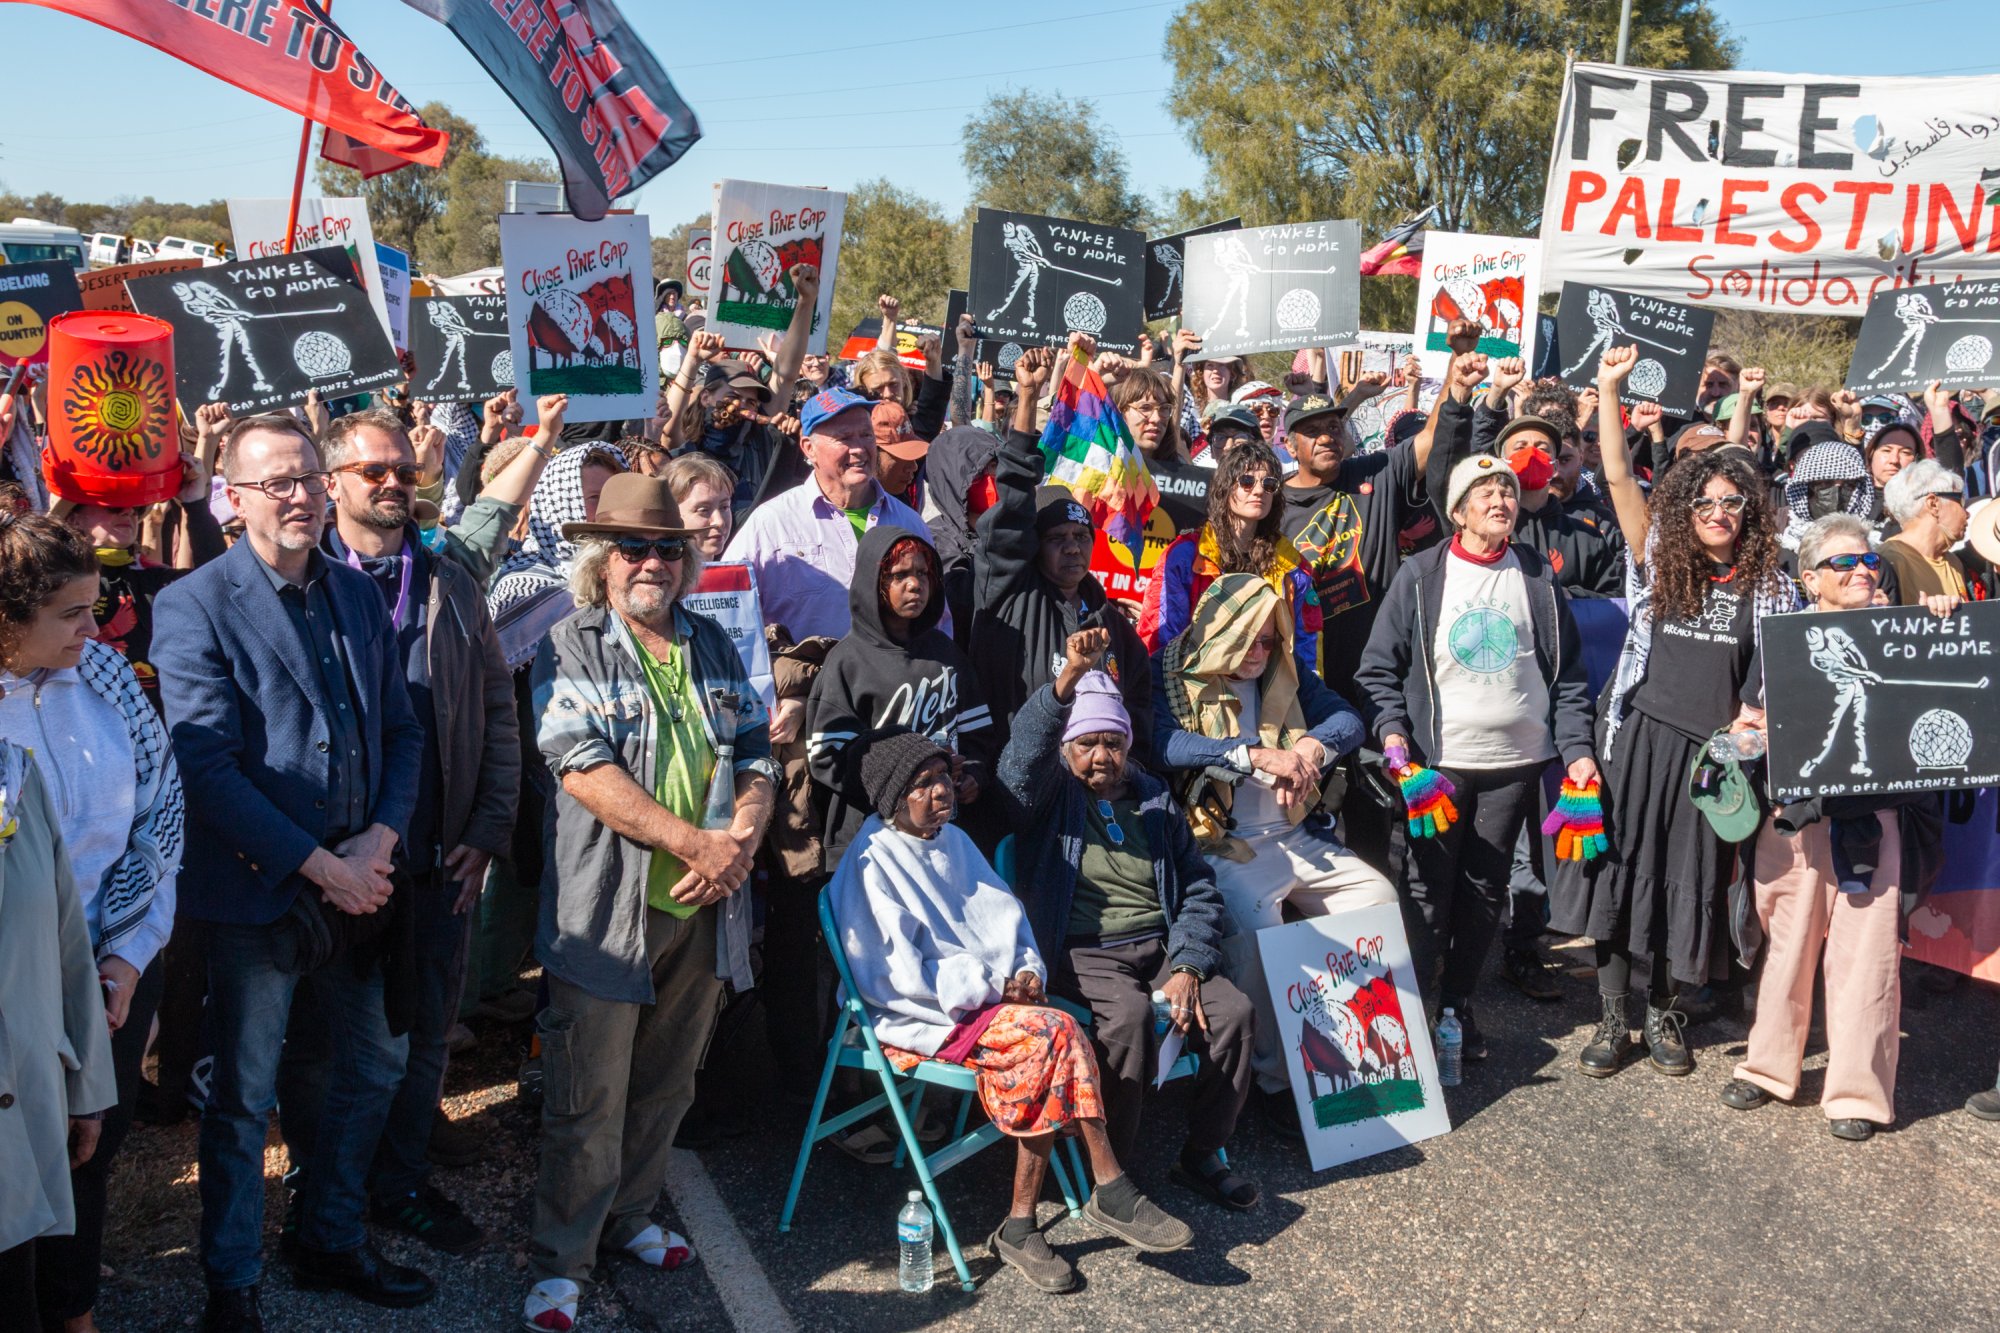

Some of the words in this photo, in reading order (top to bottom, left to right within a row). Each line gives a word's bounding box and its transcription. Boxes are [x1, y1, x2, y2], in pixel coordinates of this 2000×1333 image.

[168, 0, 272, 47] ERE
[284, 6, 345, 73] TO
[488, 0, 556, 64] ERE
[549, 46, 585, 114] TO
[1571, 71, 1860, 171] FREE
[1048, 225, 1114, 250] YANKEE
[1258, 226, 1326, 241] YANKEE
[1054, 242, 1077, 256] GO
[1083, 249, 1126, 265] HOME
[1263, 245, 1287, 256] GO
[1294, 241, 1340, 255] HOME
[227, 261, 316, 284] YANKEE
[694, 265, 711, 281] 40
[1687, 254, 1962, 307] Solidarit
[245, 287, 277, 299] GO
[286, 277, 340, 296] HOME
[1942, 283, 2000, 297] YANKE
[466, 296, 506, 307] YANK
[1629, 295, 1688, 322] YANKEE
[1945, 298, 1969, 308] GO
[1974, 296, 2000, 308] HO
[6, 314, 23, 325] ON
[474, 311, 494, 321] GO
[1630, 311, 1651, 326] GO
[1655, 319, 1695, 337] HOME
[0, 326, 44, 341] OUNTRY
[974, 325, 993, 335] INE
[1021, 331, 1041, 339] OFF
[1365, 340, 1380, 350] the
[1384, 341, 1414, 353] people
[231, 400, 254, 411] GAP
[260, 395, 283, 406] OFF
[353, 369, 399, 387] COUNTRY
[1877, 381, 1896, 390] GAP
[1900, 380, 1919, 388] OFF
[1112, 572, 1131, 592] IN
[686, 597, 740, 611] INTELLIGENCE
[1451, 597, 1512, 614] TEACH
[1871, 615, 1971, 637] YANKEE
[1883, 642, 1917, 660] GO
[1927, 640, 1993, 660] HOME
[1455, 667, 1518, 686] PEACE
[874, 665, 958, 733] Nets
[1777, 787, 1812, 797] PINE
[1818, 784, 1846, 795] GAP
[1963, 774, 2000, 786] COUNT
